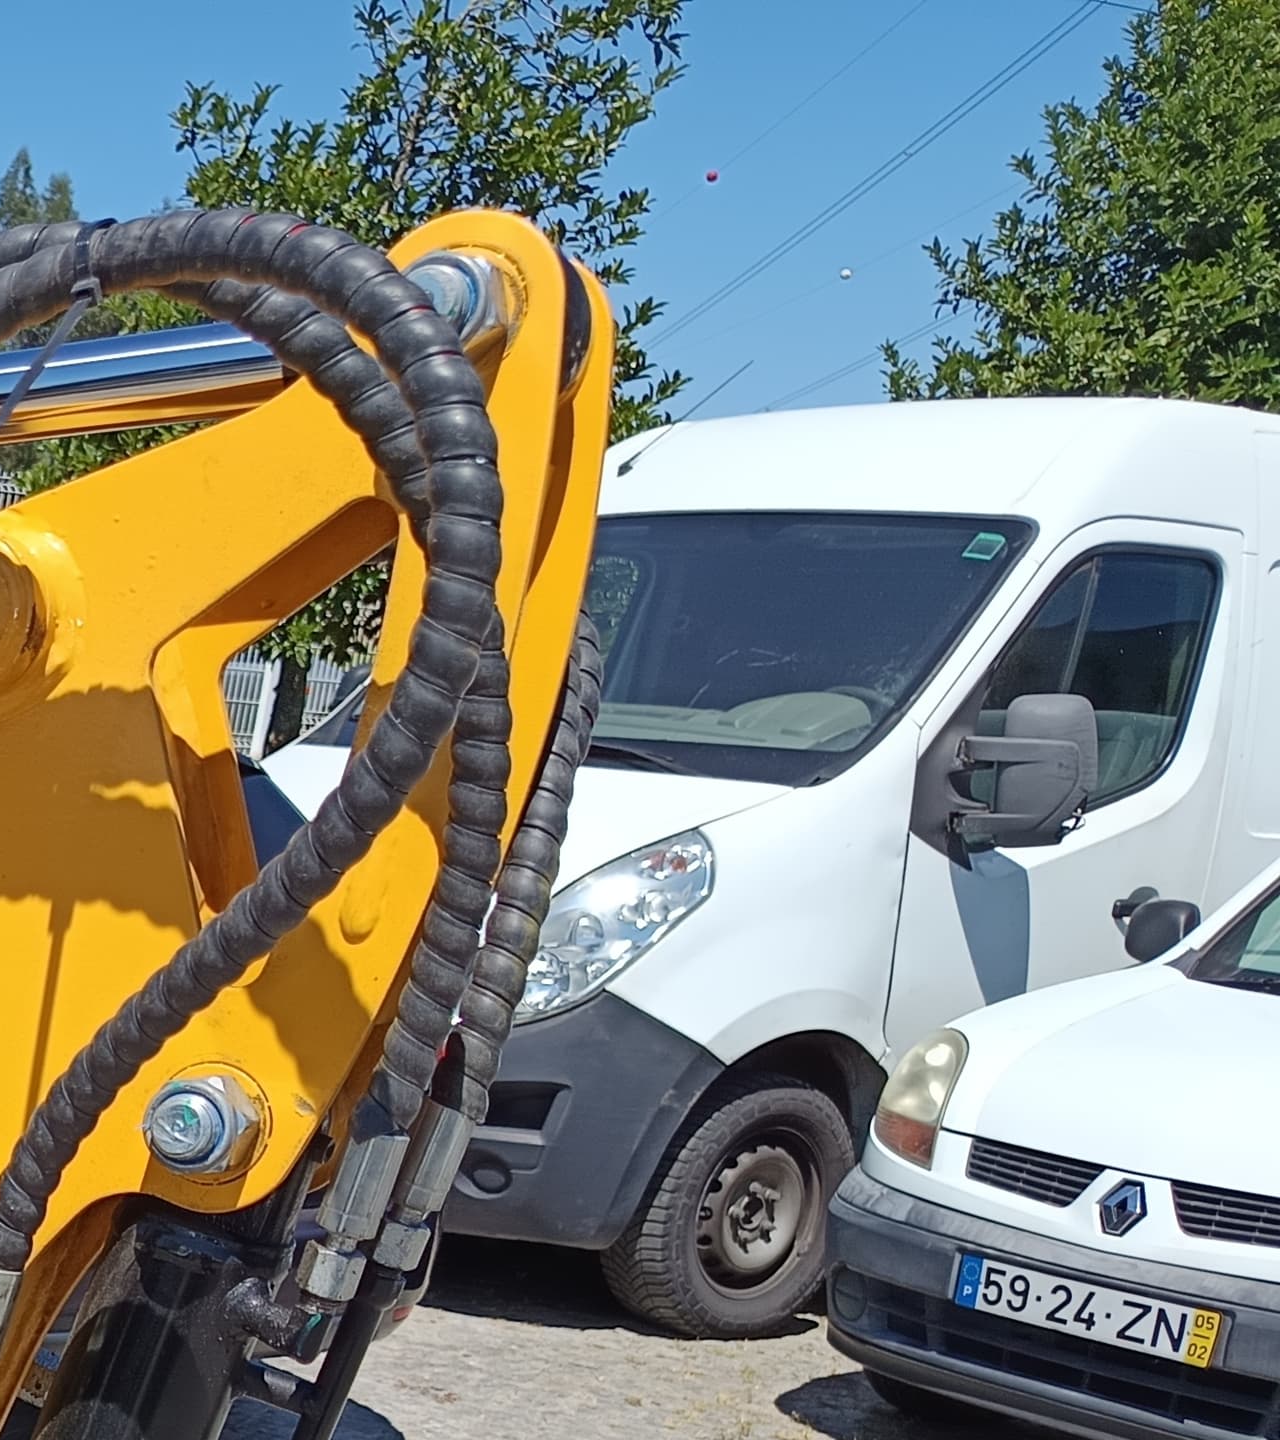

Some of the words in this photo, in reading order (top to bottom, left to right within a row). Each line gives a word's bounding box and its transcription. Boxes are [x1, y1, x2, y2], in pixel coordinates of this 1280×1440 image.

[962, 1284, 973, 1297] P
[1195, 1314, 1215, 1331] 05
[1187, 1343, 1208, 1361] 02
